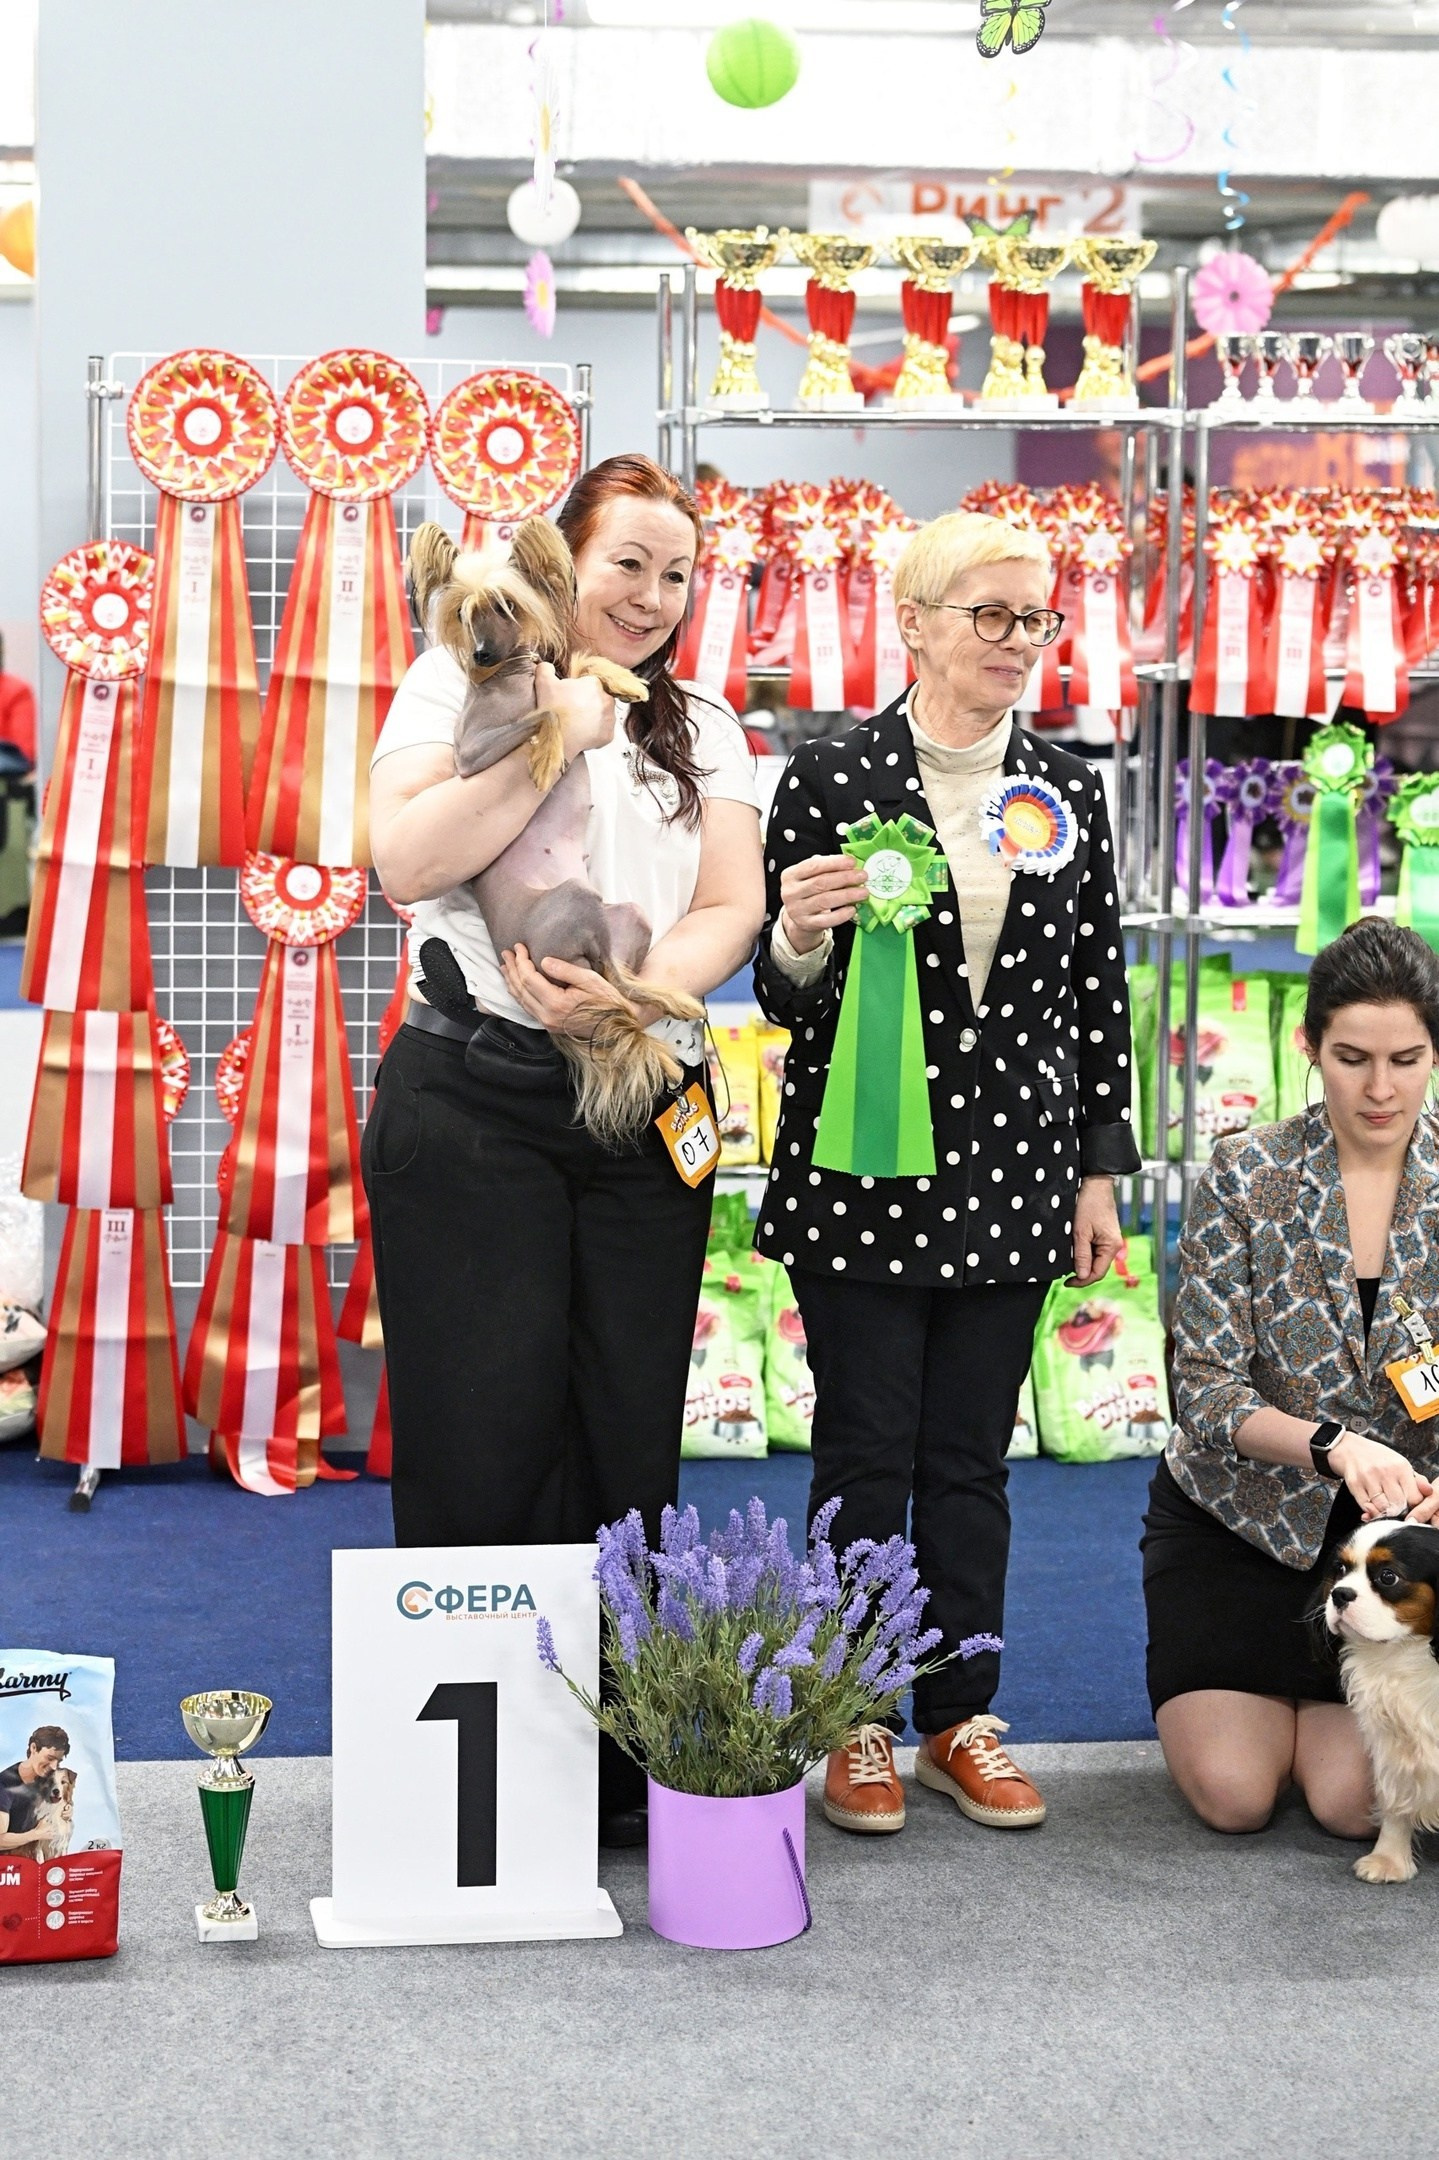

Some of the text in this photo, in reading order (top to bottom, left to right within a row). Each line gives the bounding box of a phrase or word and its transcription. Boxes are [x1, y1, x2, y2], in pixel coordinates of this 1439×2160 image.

[1082, 183, 1126, 233] 2
[682, 1126, 710, 1166] 07
[108, 1220, 125, 1232] III
[396, 1580, 537, 1621] СФЕРА
[445, 1611, 538, 1621] ВЫСТАВОЧНЫЙ ЦЕНТР
[415, 1681, 498, 1888] 1
